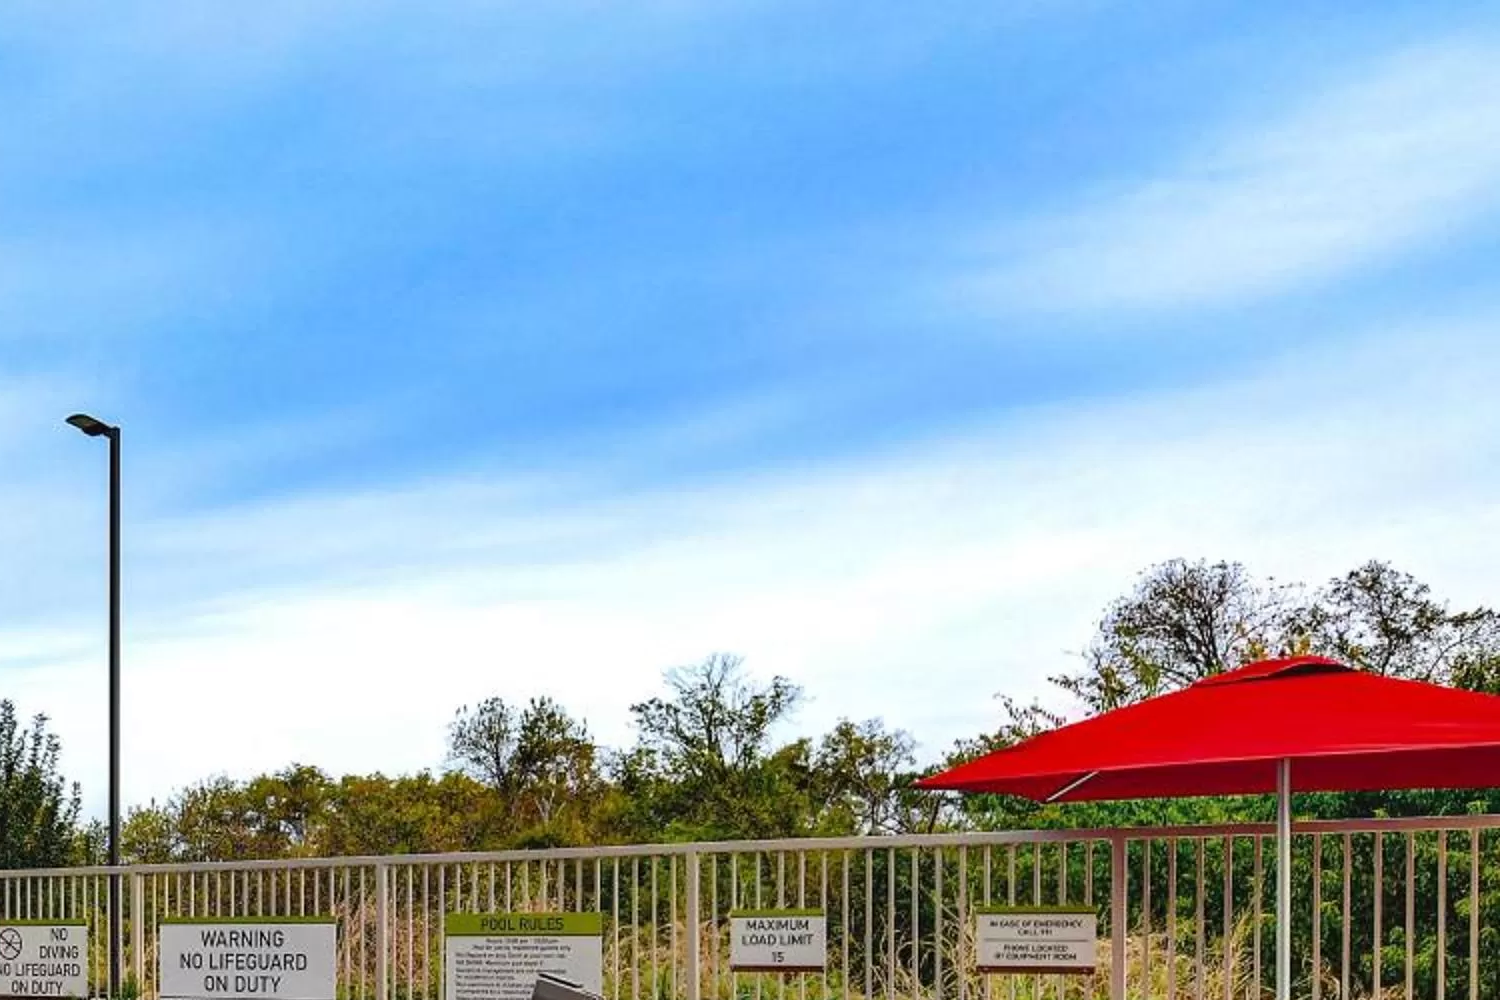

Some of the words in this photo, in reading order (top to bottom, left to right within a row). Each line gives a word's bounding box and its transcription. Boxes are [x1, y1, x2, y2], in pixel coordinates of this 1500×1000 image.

[481, 917, 515, 931] POOL
[519, 916, 565, 931] RULES
[746, 920, 809, 930] MAXIMUM
[51, 928, 68, 941] NO
[201, 930, 284, 948] WARNING
[741, 935, 777, 945] LOAD
[780, 934, 814, 945] LIMIT
[39, 945, 79, 959] DIVING
[771, 951, 785, 963] 15
[180, 953, 202, 969] NO
[209, 953, 308, 971] LIFEGUARD
[15, 963, 80, 977] LIFEGUARD
[11, 981, 28, 993] ON
[31, 981, 63, 994] DUTY
[204, 975, 228, 992] ON
[235, 976, 281, 993] DUTY
